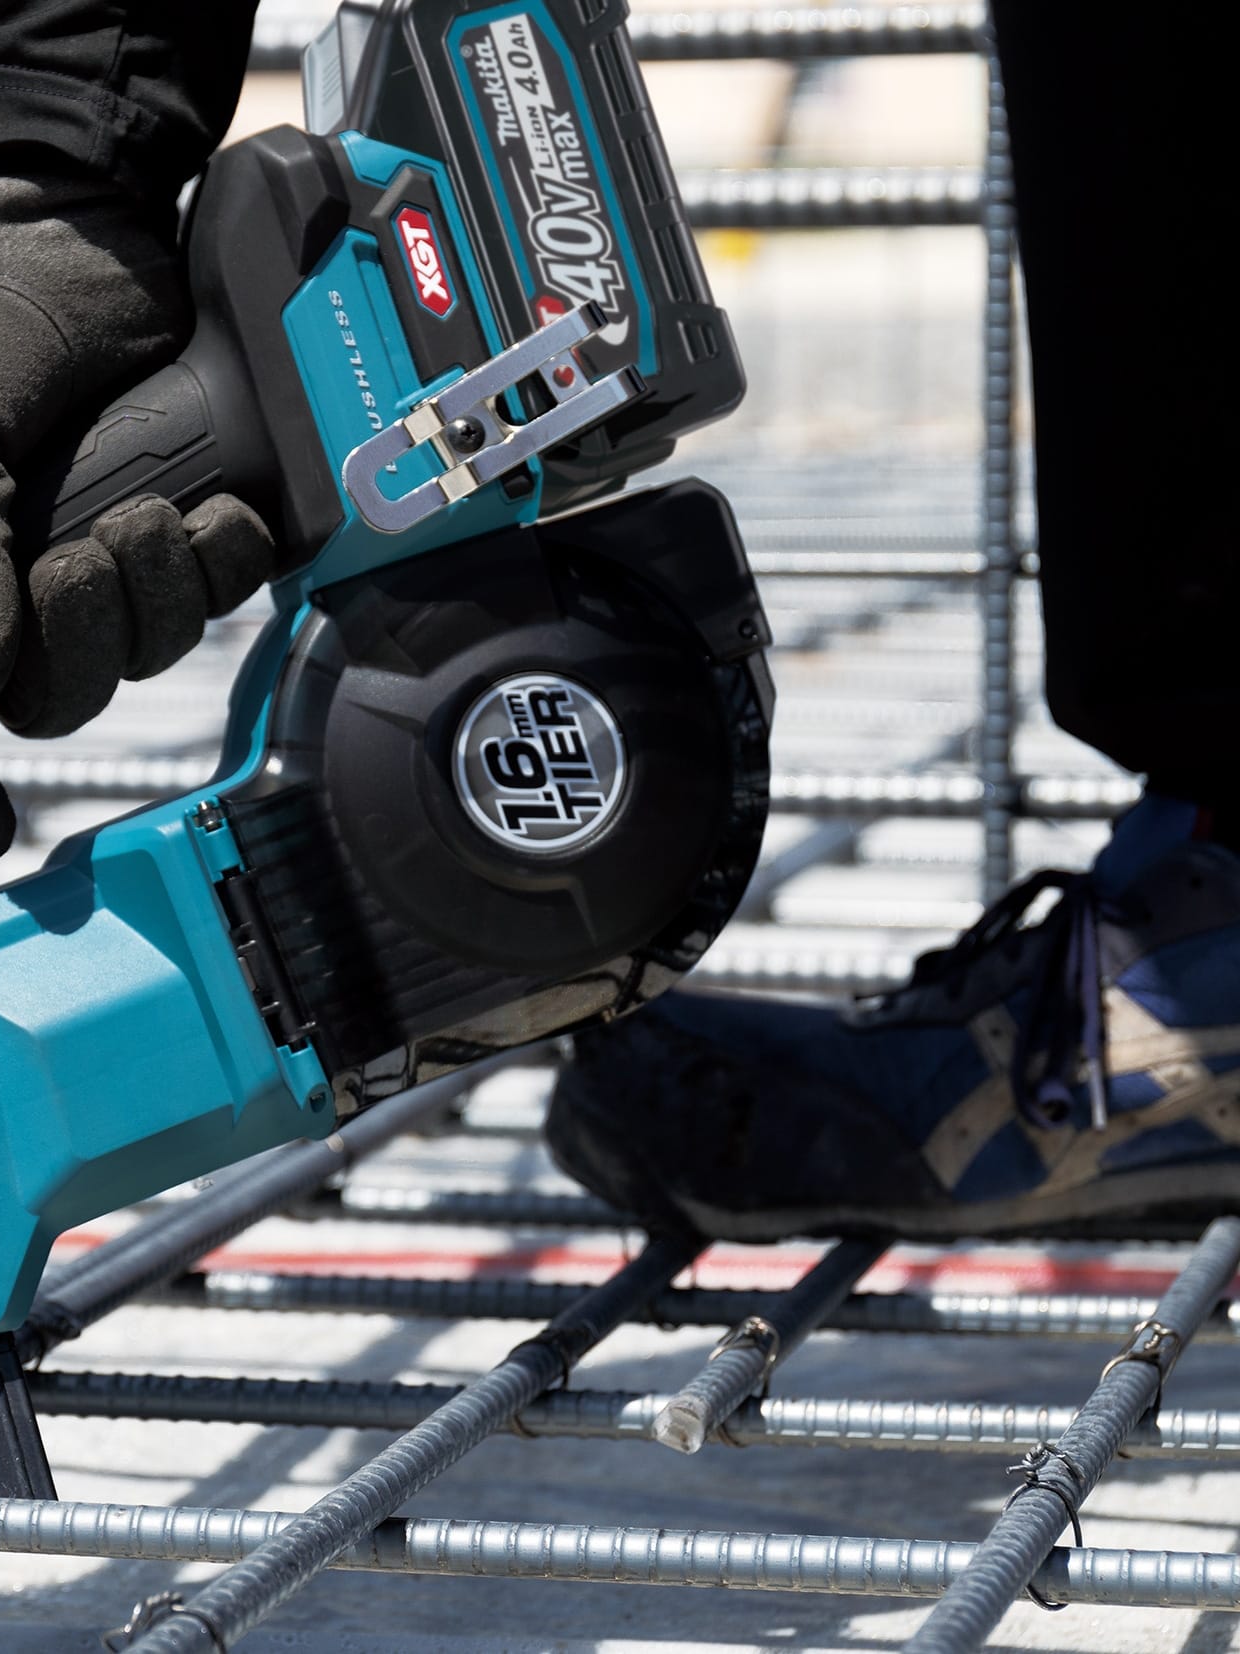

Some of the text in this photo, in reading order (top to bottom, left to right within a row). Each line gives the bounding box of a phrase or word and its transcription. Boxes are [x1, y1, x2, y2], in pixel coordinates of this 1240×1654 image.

[475, 35, 521, 147] makita
[507, 23, 540, 95] 4.0Ah
[400, 220, 449, 301] XGT
[328, 290, 397, 472] USHLESS
[528, 689, 603, 820] TIER
